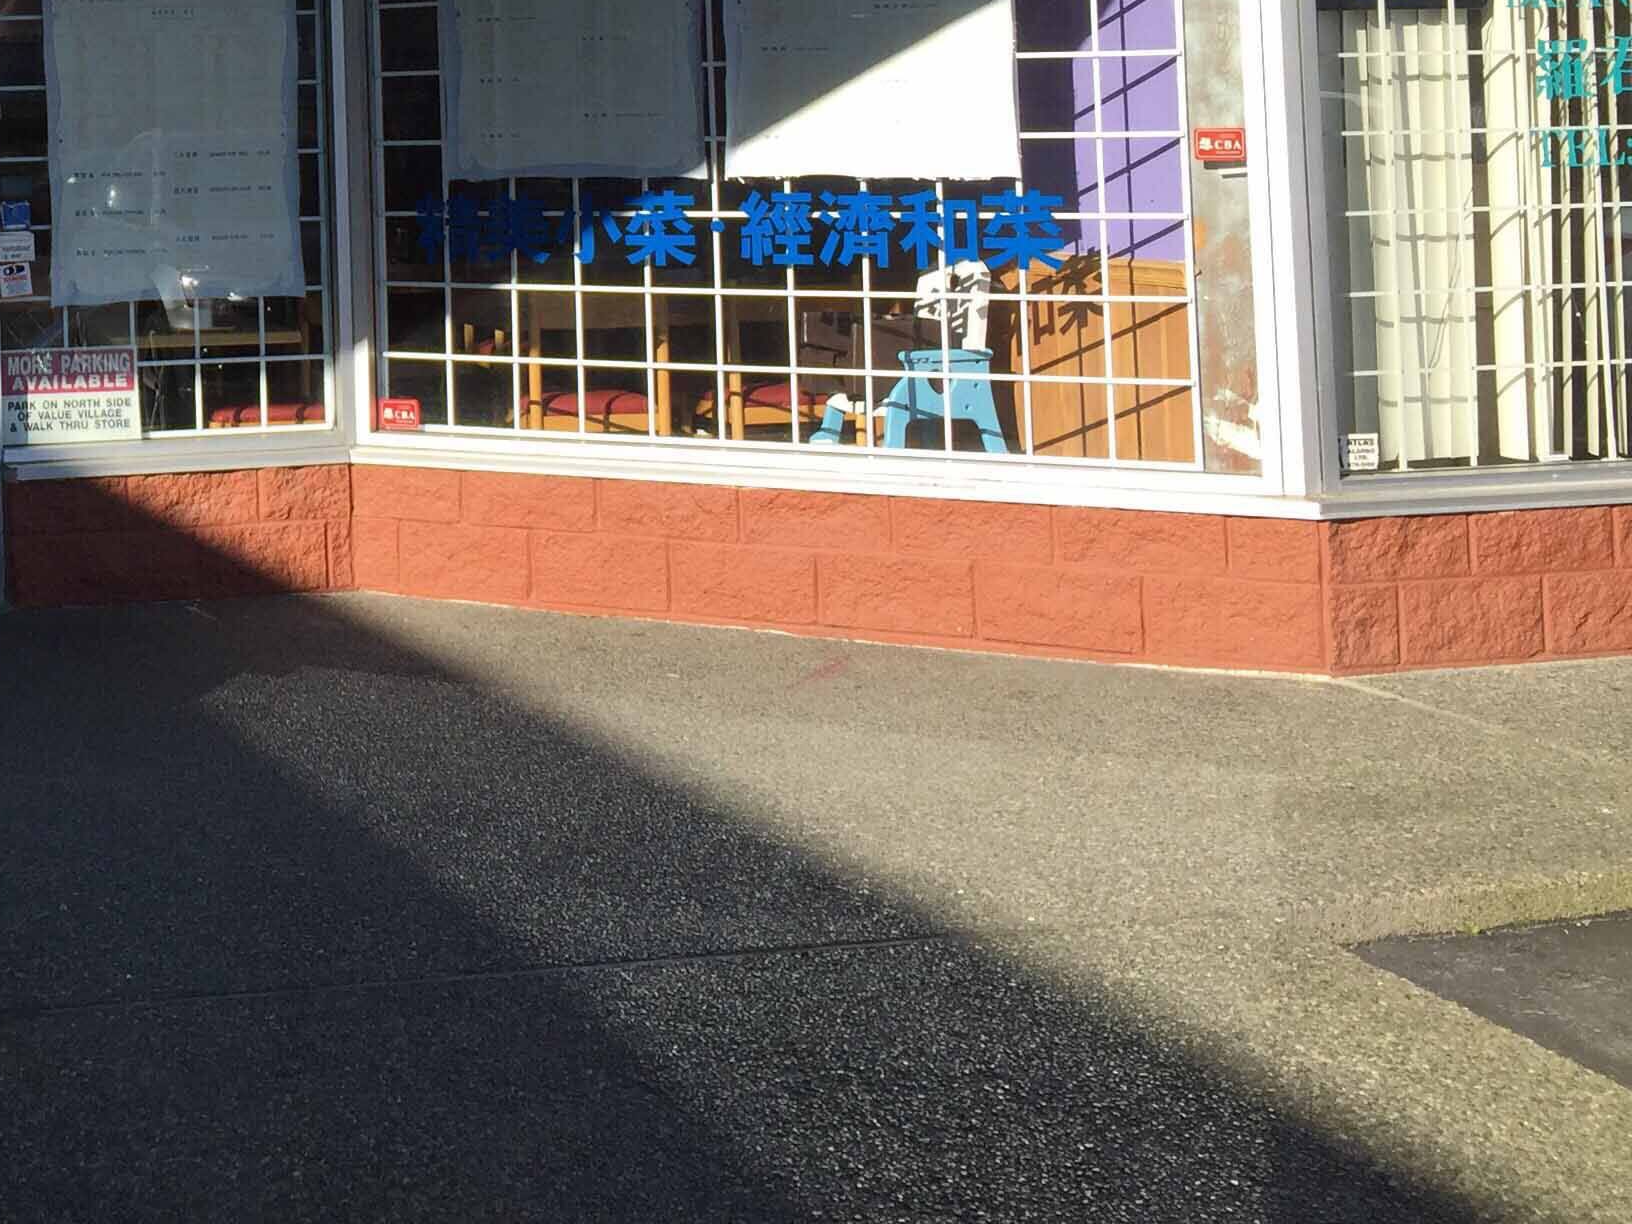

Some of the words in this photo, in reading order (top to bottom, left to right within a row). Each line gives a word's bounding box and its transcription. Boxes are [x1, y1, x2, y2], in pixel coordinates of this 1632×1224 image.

[6, 352, 53, 376] MORE
[60, 352, 131, 375] PARKING
[12, 374, 129, 391] AVAILABLE
[8, 399, 36, 411] PARK
[42, 399, 58, 410] ON
[64, 398, 101, 409] NORTH
[106, 397, 131, 407] SIDE
[17, 411, 32, 422] OF
[38, 410, 71, 420] VALUE
[77, 408, 122, 419] VILLAGE
[23, 421, 53, 432] WALK
[59, 419, 88, 430] THRU
[95, 418, 131, 429] STORE
